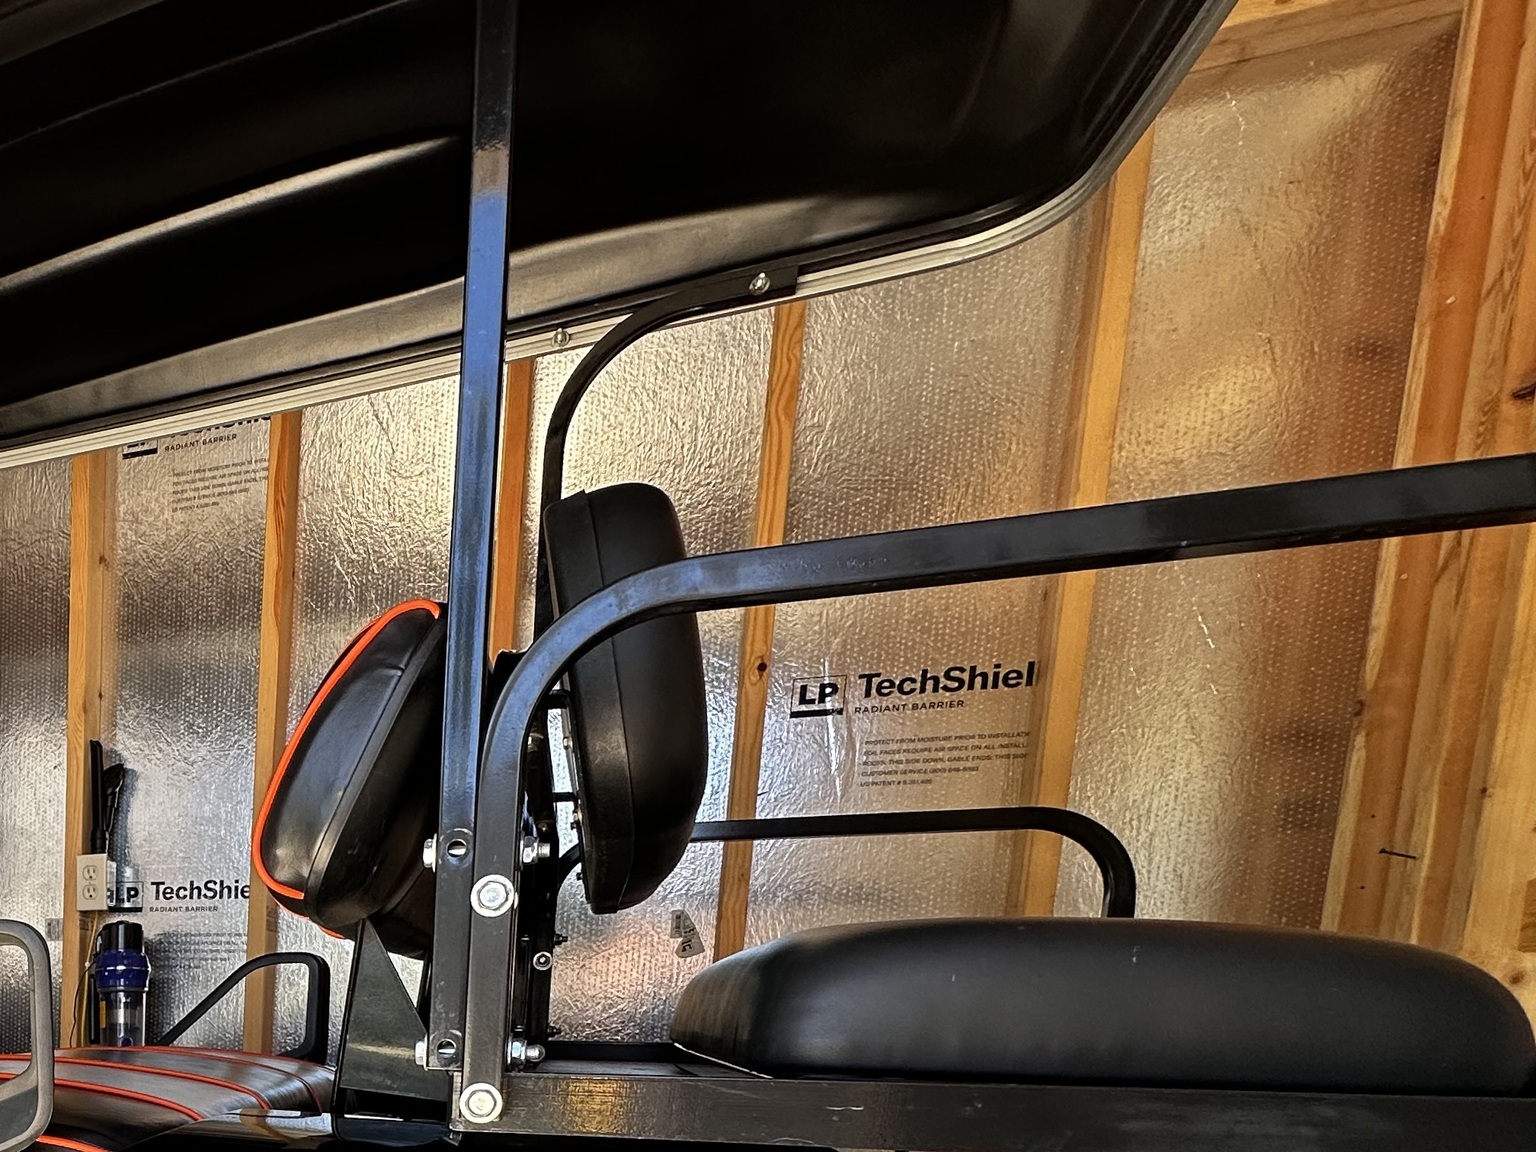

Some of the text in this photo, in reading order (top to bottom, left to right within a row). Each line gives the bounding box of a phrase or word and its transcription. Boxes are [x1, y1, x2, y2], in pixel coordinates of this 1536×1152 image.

[164, 433, 238, 453] RADIANT BARRIER
[798, 682, 839, 706] LP
[854, 699, 965, 715] RADIANT BARRIER
[149, 905, 183, 913] RADIANT
